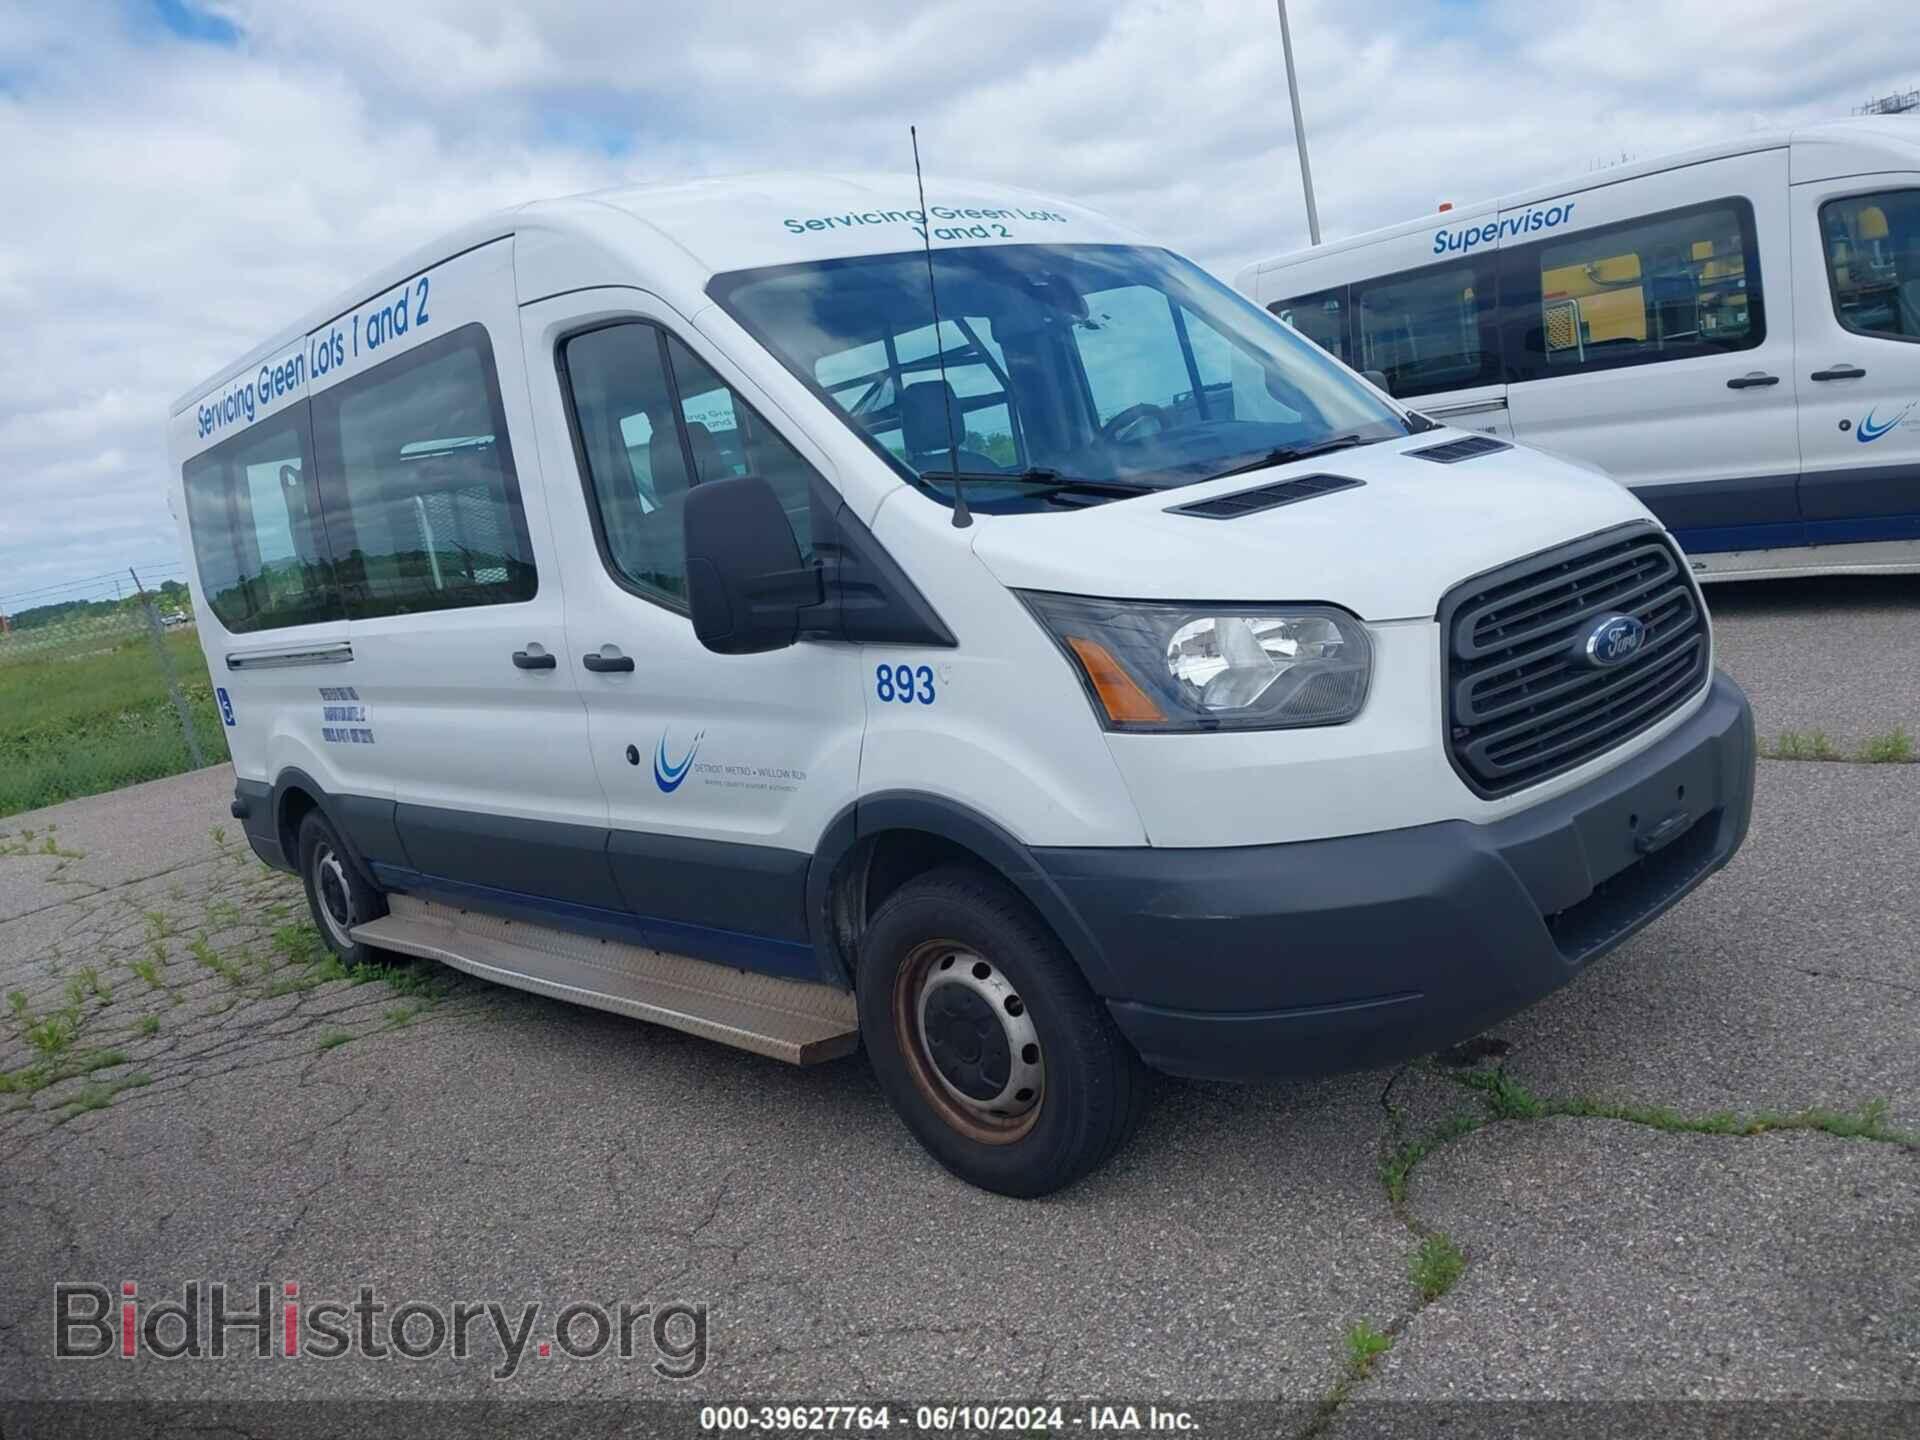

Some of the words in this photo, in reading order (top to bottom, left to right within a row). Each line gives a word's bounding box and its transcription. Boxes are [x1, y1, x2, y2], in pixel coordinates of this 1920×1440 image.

[783, 208, 928, 235] Servicing
[930, 206, 1015, 220] Green
[1017, 207, 1068, 223] Lots
[934, 223, 990, 240] and
[991, 223, 1013, 239] 2
[1433, 202, 1575, 254] Supervisor
[197, 380, 255, 439] Servicing
[256, 352, 306, 405] Green
[309, 327, 345, 380] Lots
[366, 286, 410, 349] and
[415, 276, 430, 327] 2
[1607, 625, 1637, 657] Ford
[876, 663, 936, 705] 893
[725, 765, 751, 777] METRO
[758, 767, 790, 778] WILLOW
